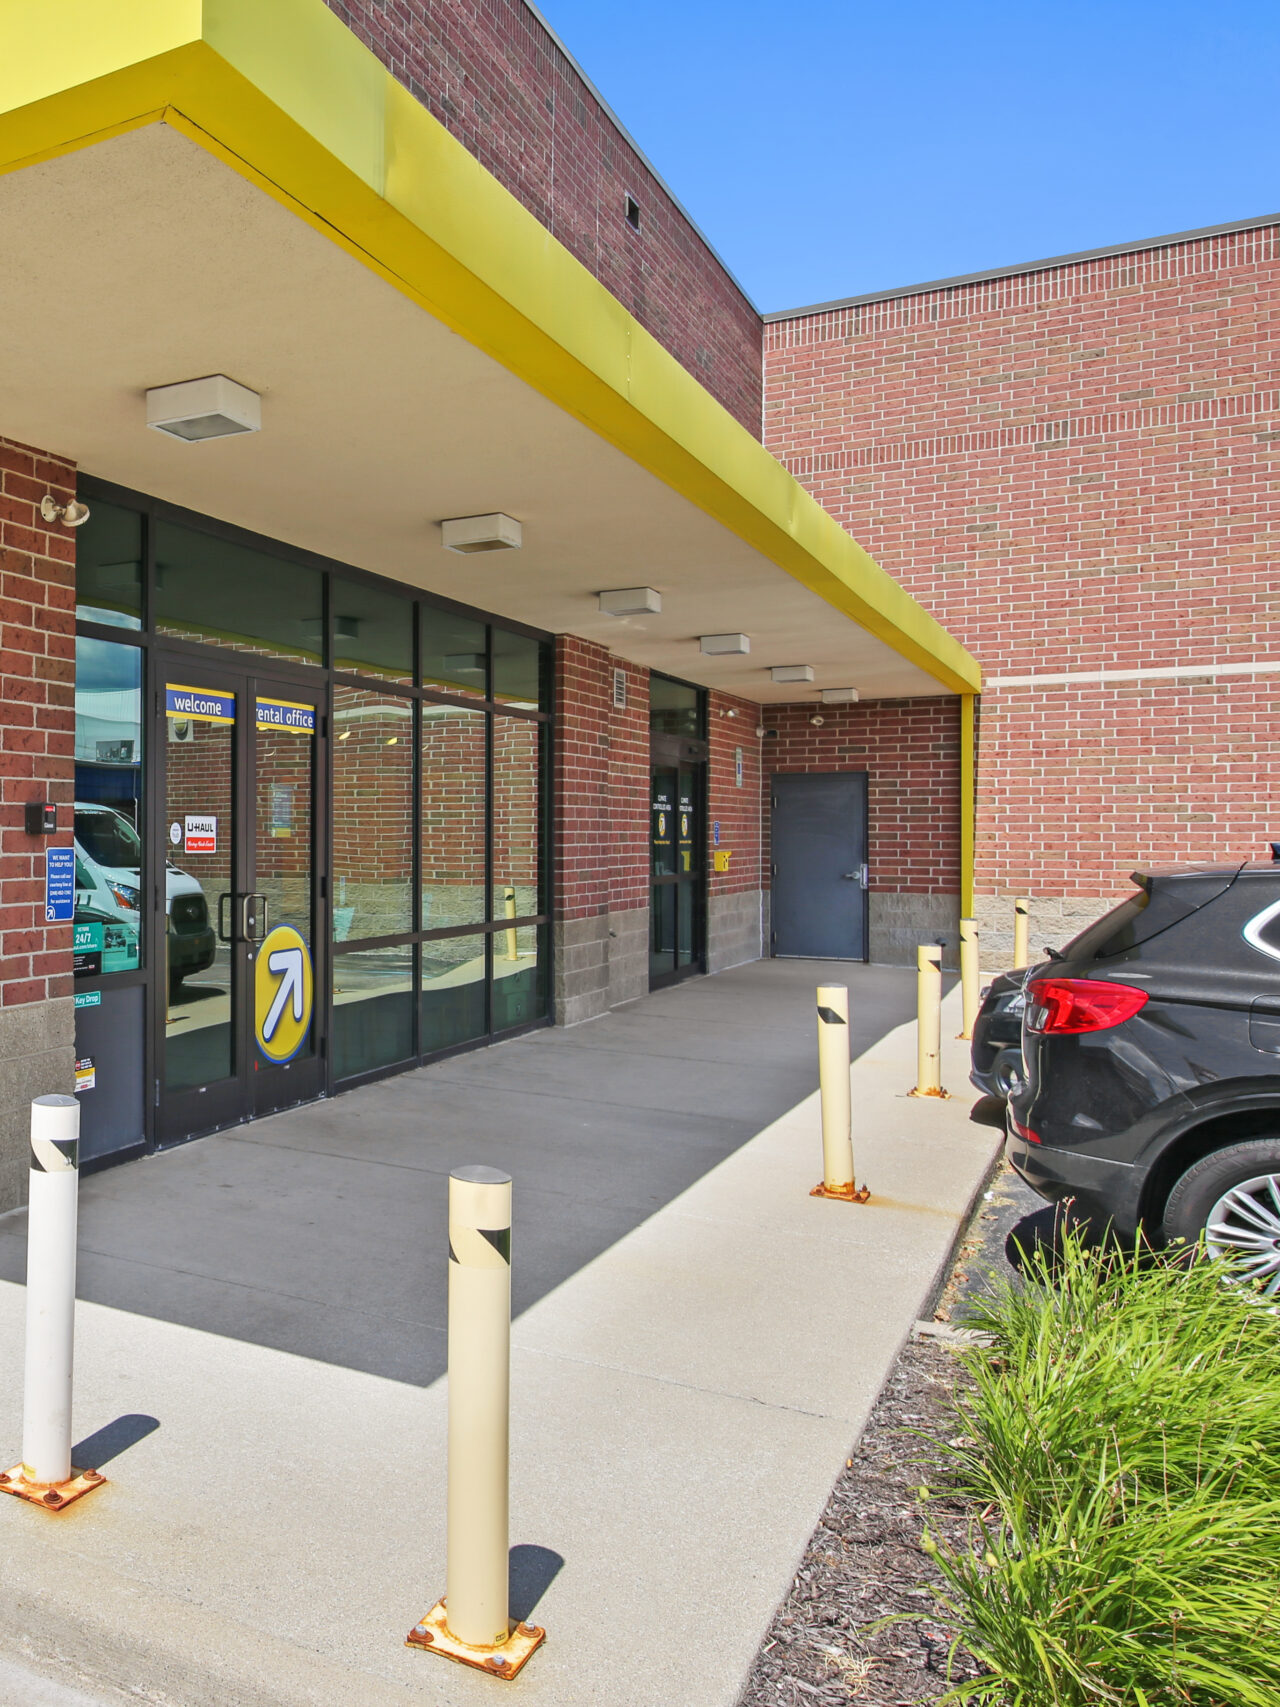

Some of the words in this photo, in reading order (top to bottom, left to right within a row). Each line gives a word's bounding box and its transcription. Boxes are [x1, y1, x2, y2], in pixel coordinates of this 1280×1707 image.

[174, 694, 222, 715] welcome
[286, 709, 313, 727] office
[75, 933, 91, 944] 24/7
[75, 996, 85, 1005] Key
[86, 995, 98, 1003] Drop
